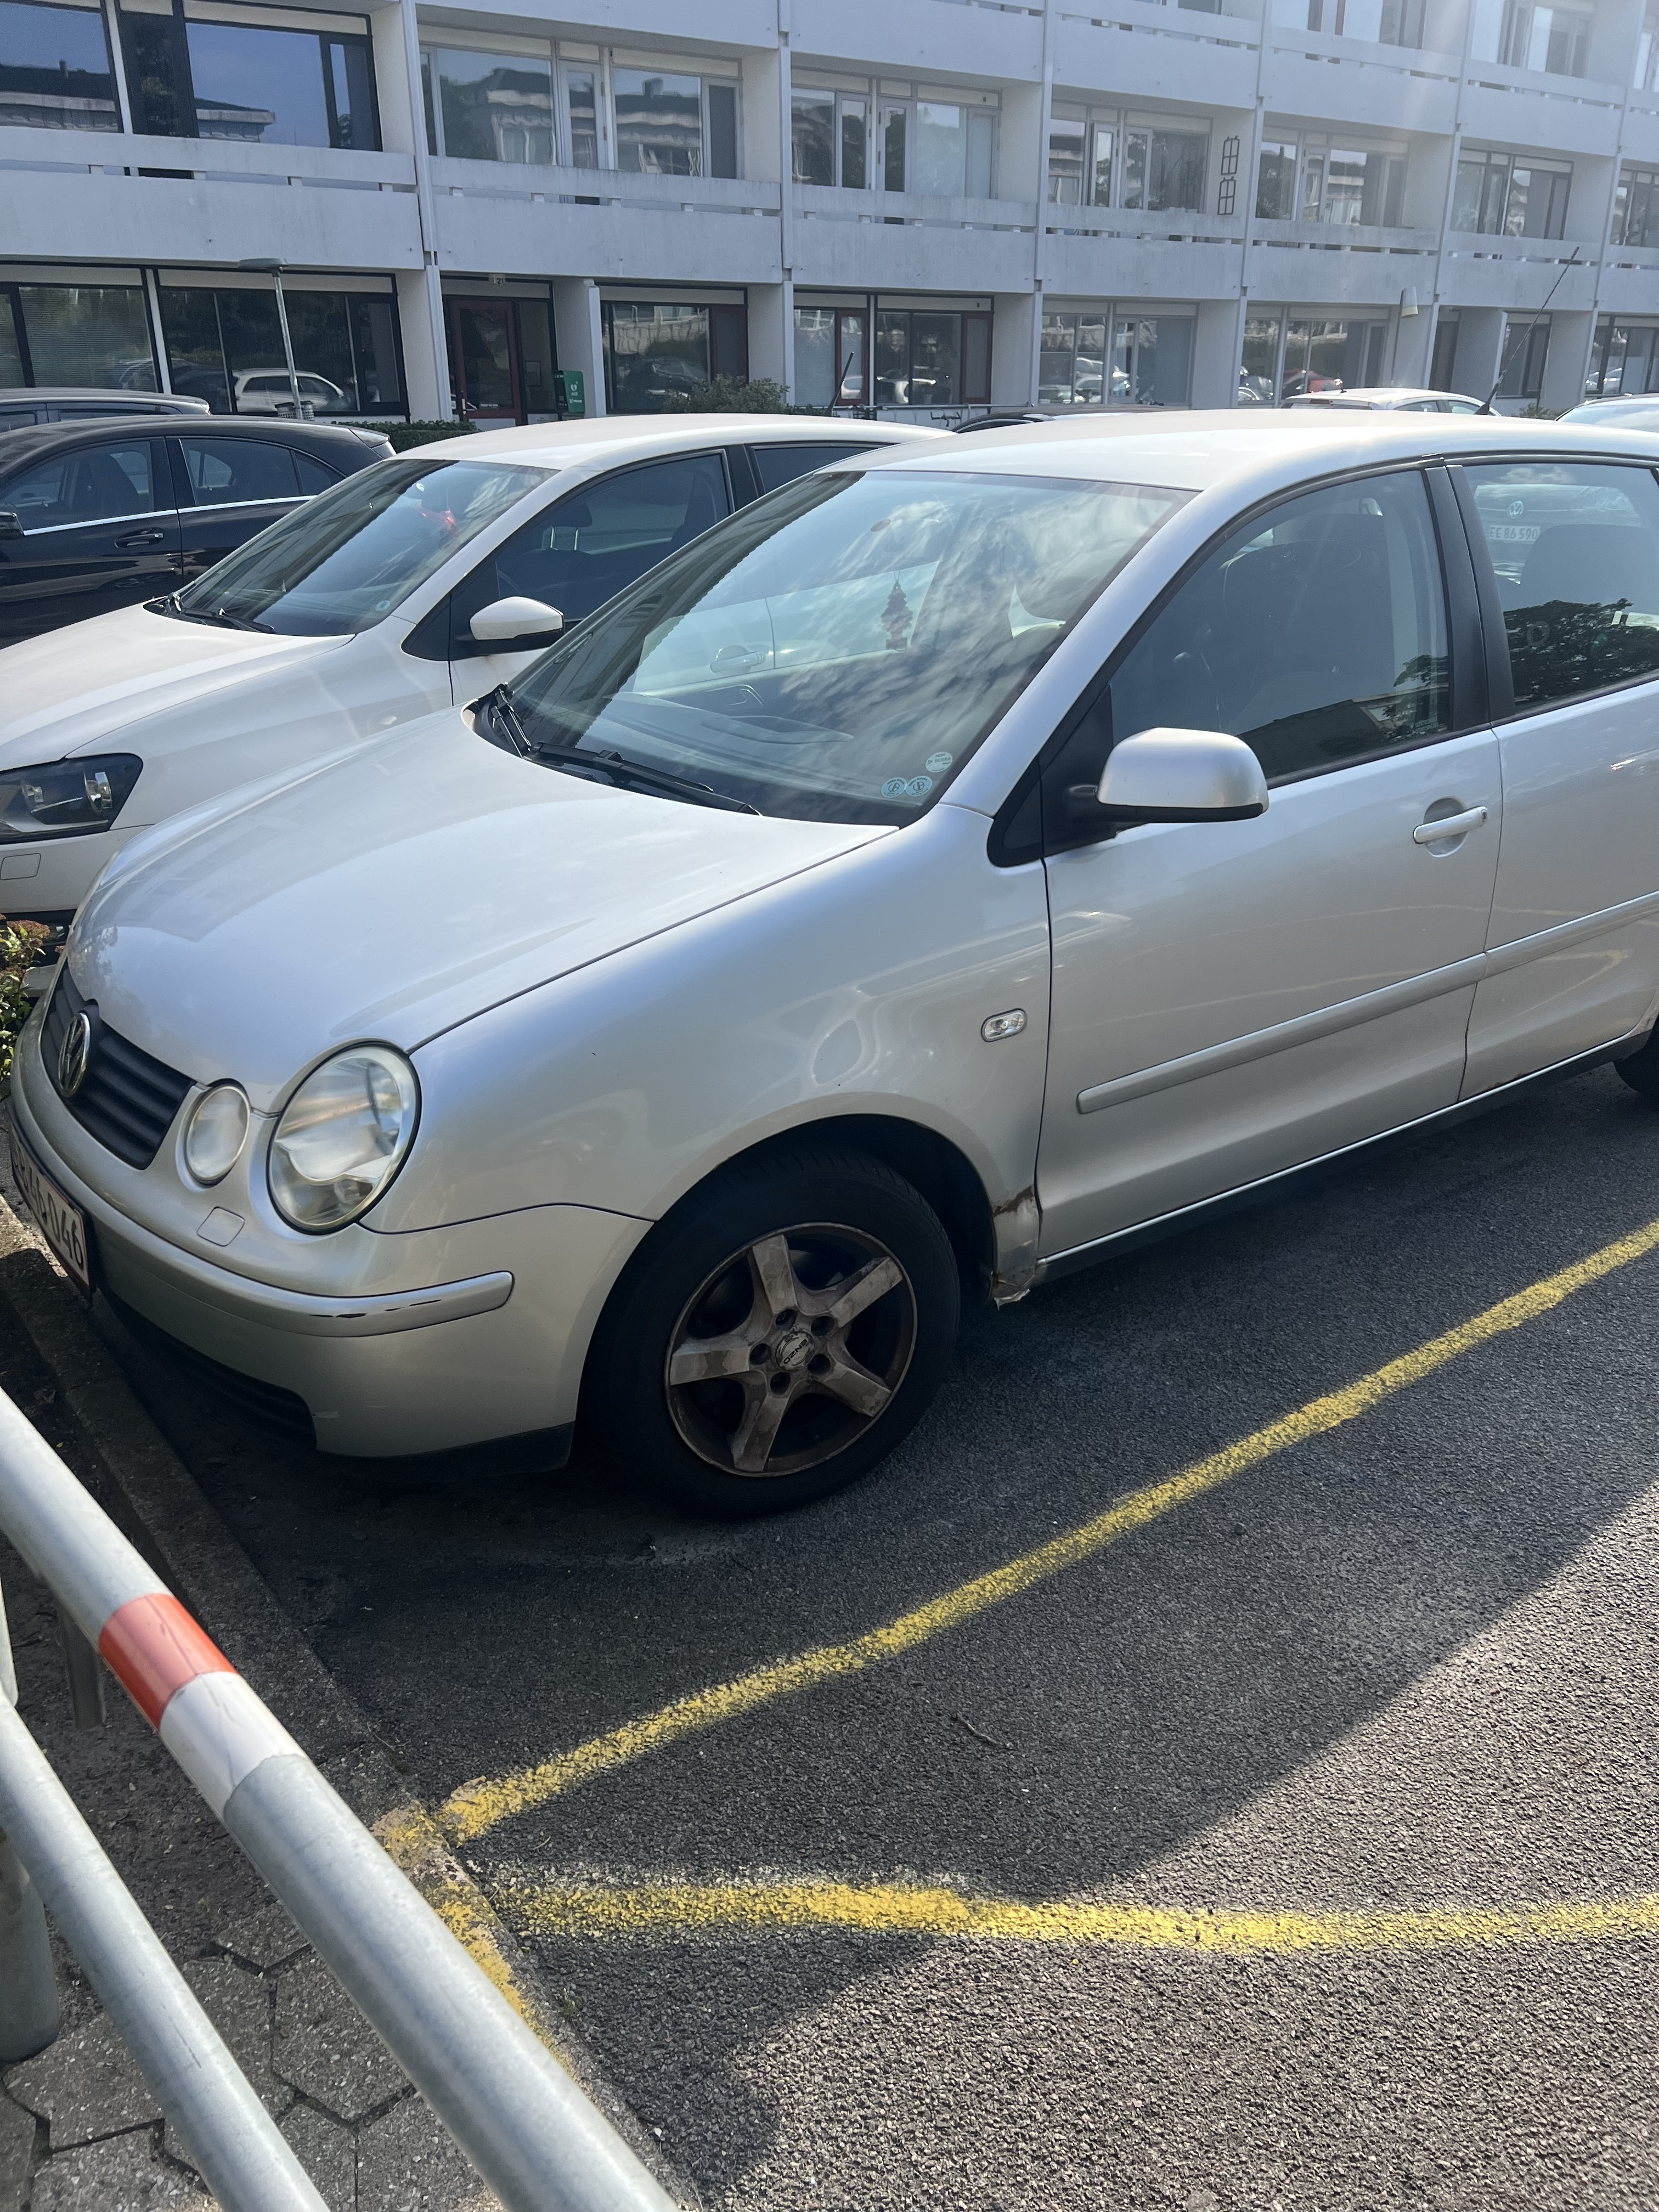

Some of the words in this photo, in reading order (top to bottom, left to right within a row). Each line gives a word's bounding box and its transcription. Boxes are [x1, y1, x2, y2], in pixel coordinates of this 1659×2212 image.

[1490, 527, 1502, 538] EE
[1504, 527, 1517, 539] 86
[1519, 528, 1538, 540] 590
[48, 1192, 84, 1271] 046
[783, 1339, 808, 1364] ENZO
